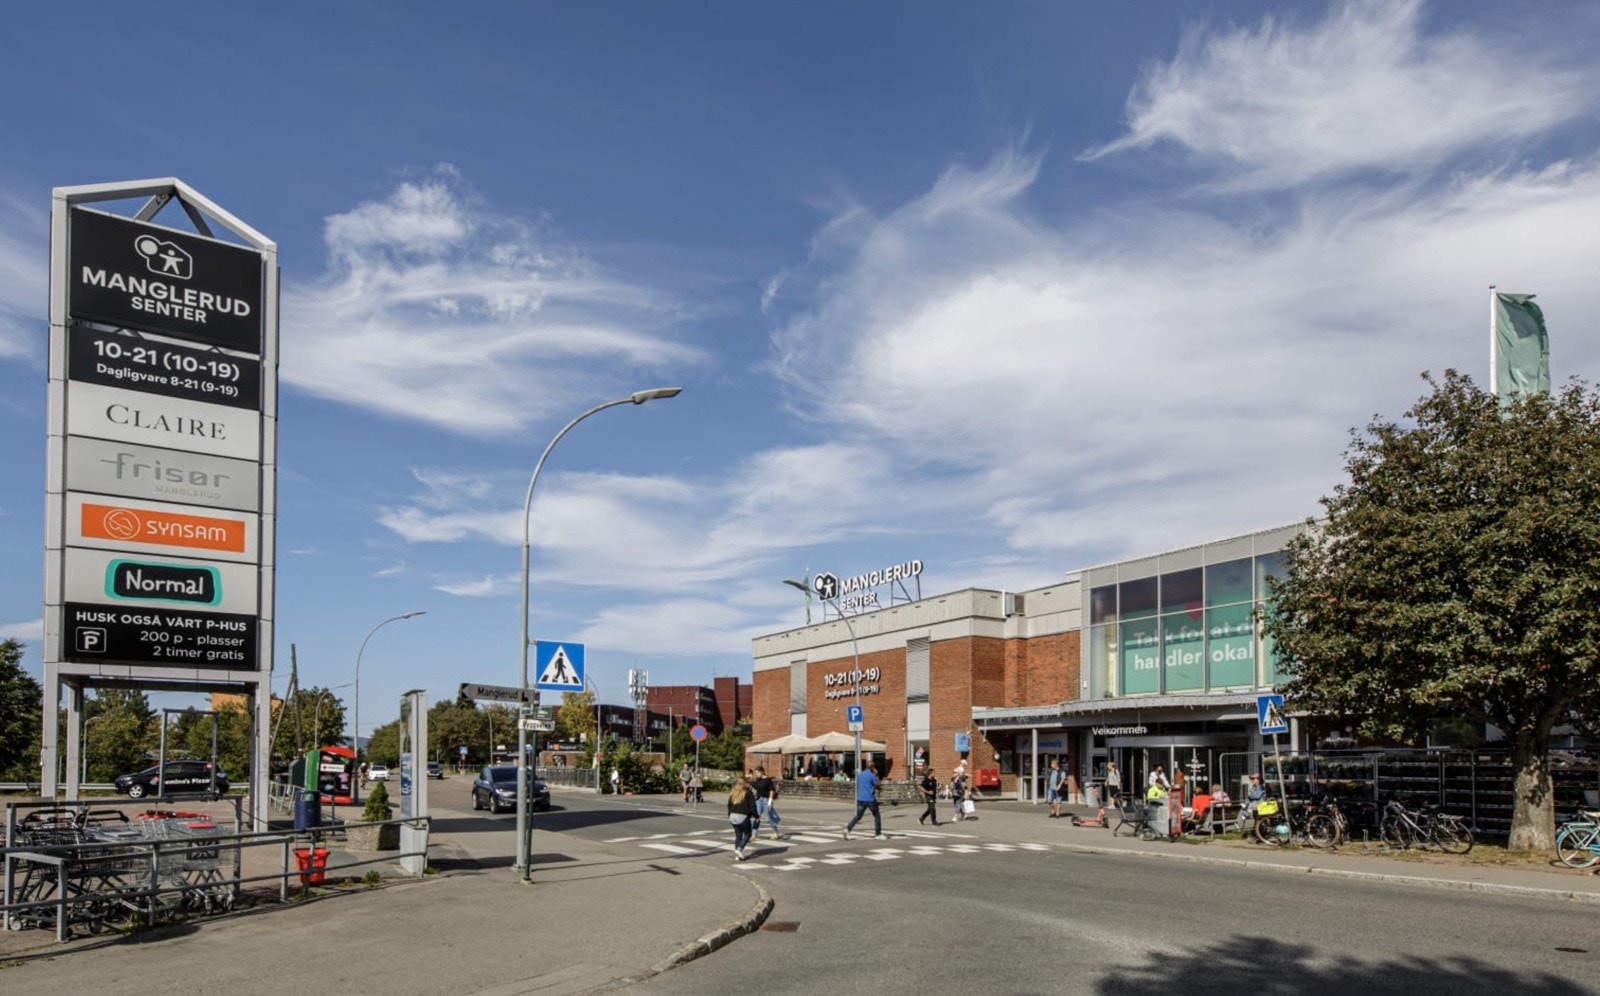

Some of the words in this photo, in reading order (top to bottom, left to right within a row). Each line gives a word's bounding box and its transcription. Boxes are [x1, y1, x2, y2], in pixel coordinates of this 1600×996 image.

[82, 266, 250, 316] MANGLERUD
[131, 296, 207, 323] SENTER
[94, 340, 157, 365] 10-21
[163, 352, 240, 381] (10-19)
[97, 363, 168, 384] Dagligvare
[170, 376, 199, 389] 8-21
[201, 381, 239, 397] (9-19)
[106, 404, 226, 440] CLAIRE
[100, 452, 231, 488] frisør
[146, 520, 226, 542] SYNSAM
[126, 569, 204, 595] Normal
[841, 560, 923, 595] MANGLERUD
[841, 592, 877, 610] SENTER
[76, 611, 117, 623] HUSK
[121, 614, 162, 627] OGSÅ
[166, 617, 203, 629] VÅRT
[206, 620, 247, 632] P-HUS
[84, 635, 98, 650] P
[140, 631, 170, 643] 200
[174, 633, 183, 645] p
[197, 634, 245, 647] plasser
[153, 646, 162, 656] 2
[166, 647, 203, 658] timer
[206, 650, 245, 661] gratis
[1212, 641, 1254, 662] okal
[824, 672, 847, 686] 10-21
[848, 667, 880, 684] (10-19)
[477, 687, 518, 699] Manglerud
[851, 708, 860, 721] P
